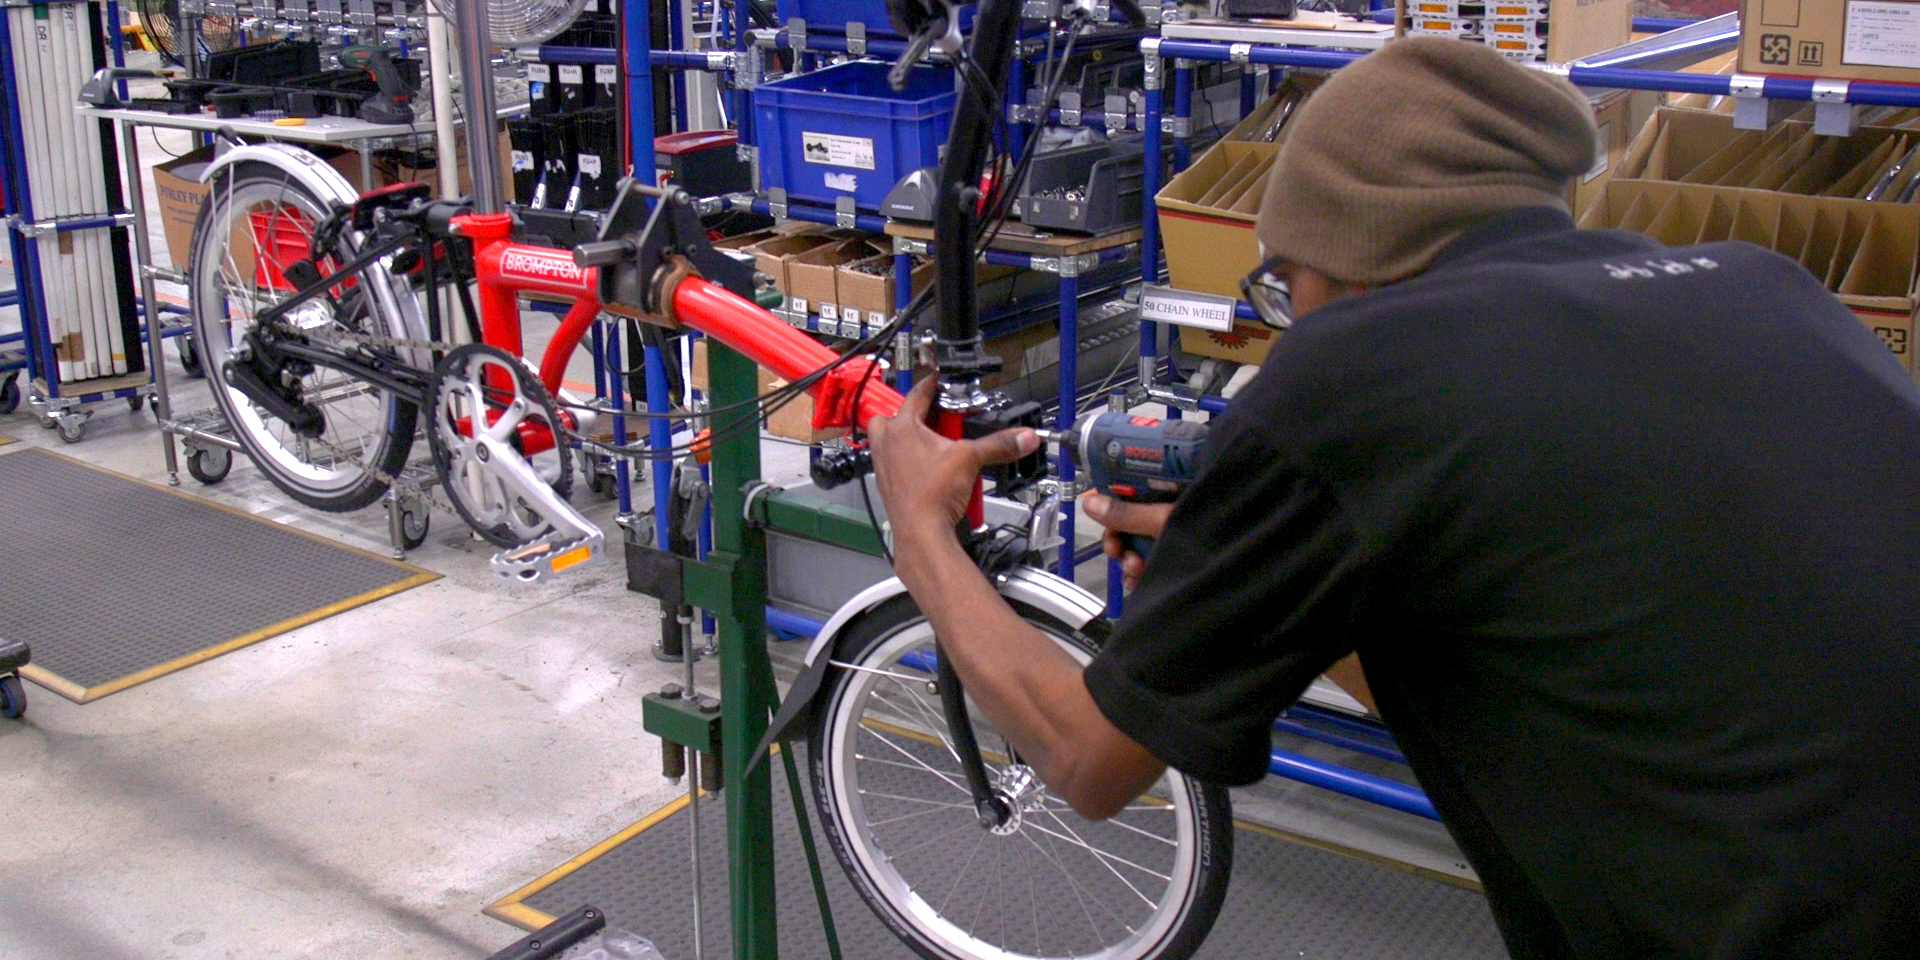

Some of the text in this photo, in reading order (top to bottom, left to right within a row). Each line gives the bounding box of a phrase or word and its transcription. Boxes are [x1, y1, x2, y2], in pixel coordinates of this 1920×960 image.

[506, 253, 581, 280] BROMPTON
[1144, 301, 1228, 321] 50 CHAIN WHEEL
